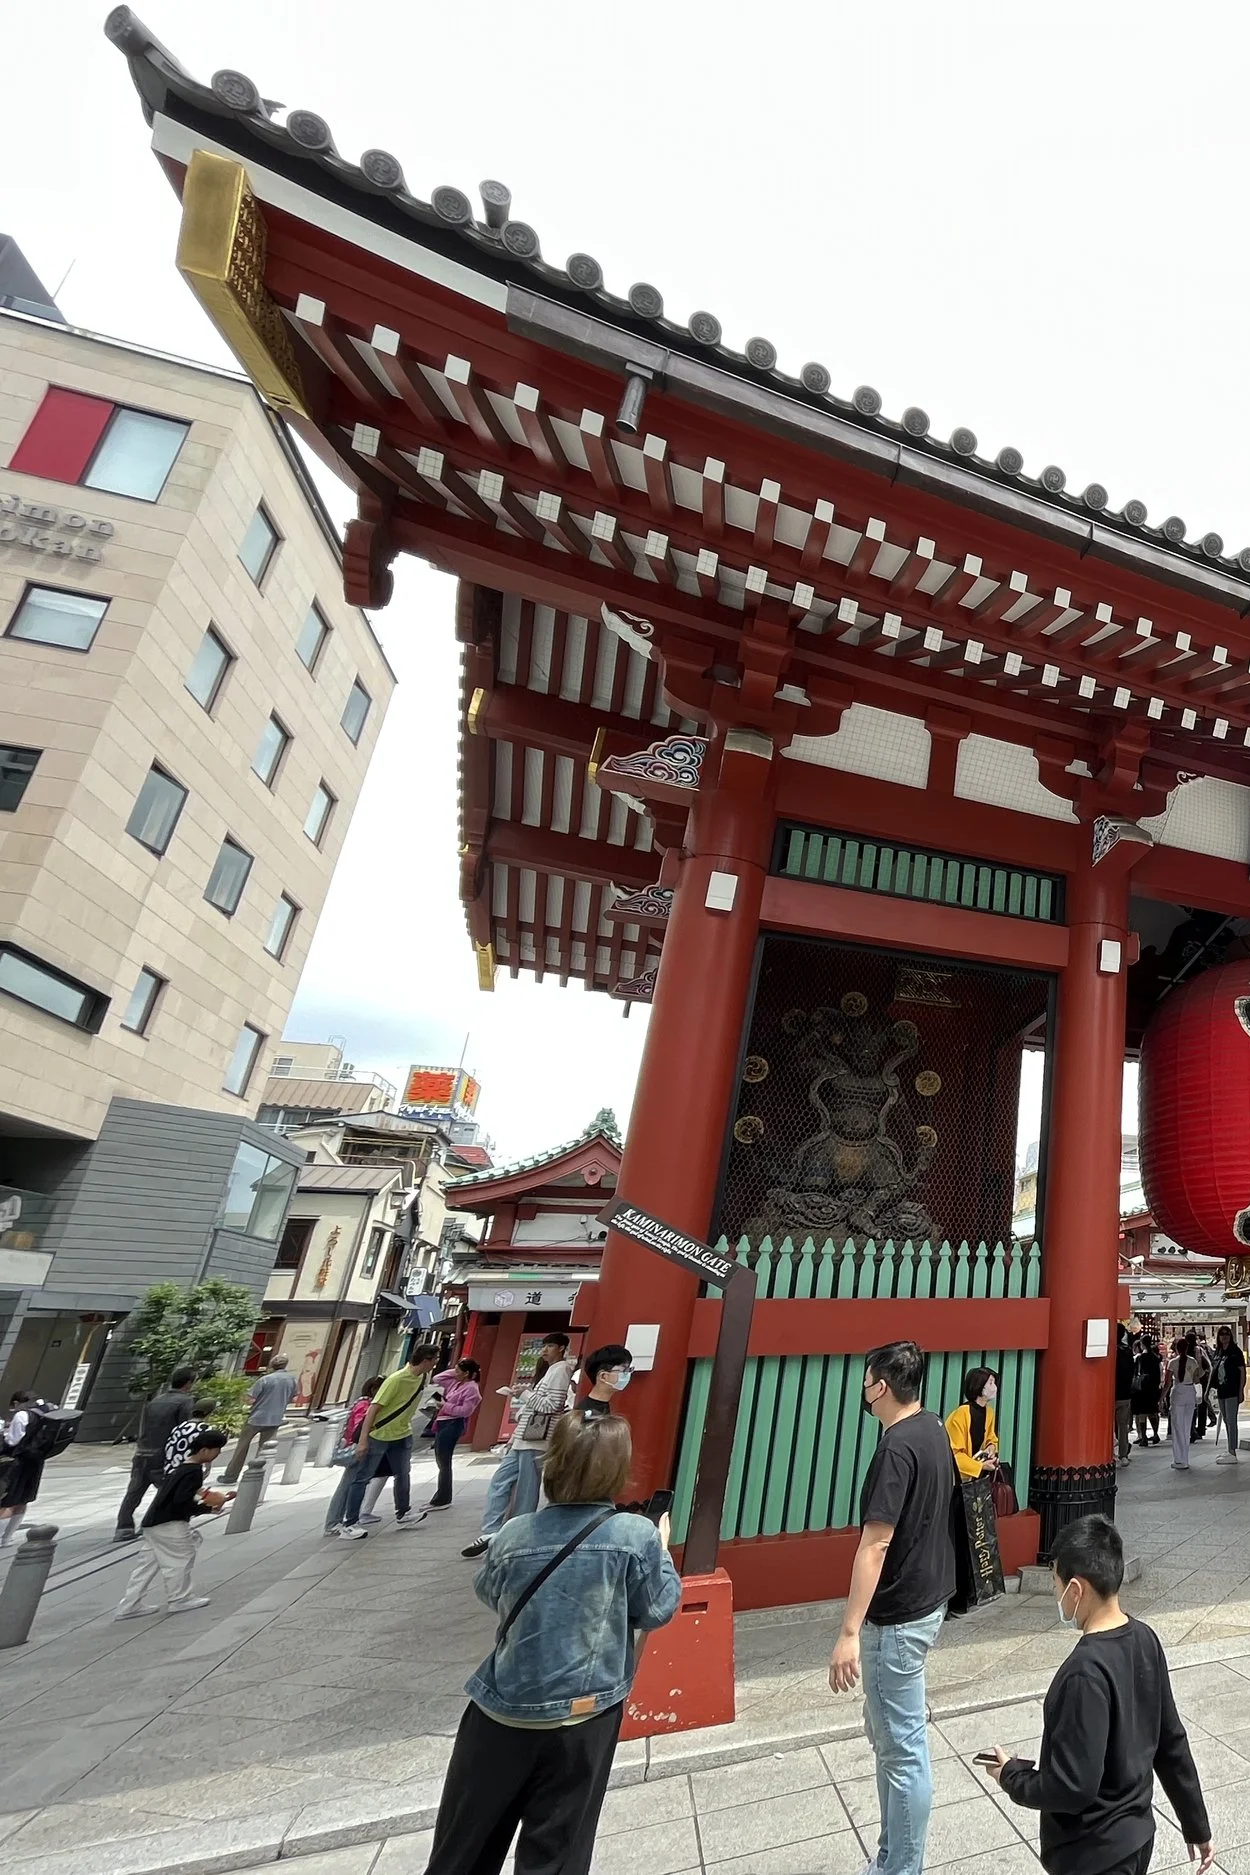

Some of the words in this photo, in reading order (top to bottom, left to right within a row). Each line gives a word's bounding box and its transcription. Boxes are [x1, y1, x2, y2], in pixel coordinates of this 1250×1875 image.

[408, 1071, 457, 1104] 薬
[622, 1208, 704, 1256] KAMINARIMON
[700, 1252, 732, 1273] GATE
[974, 1516, 990, 1549] Potter
[979, 1548, 994, 1578] Harry
